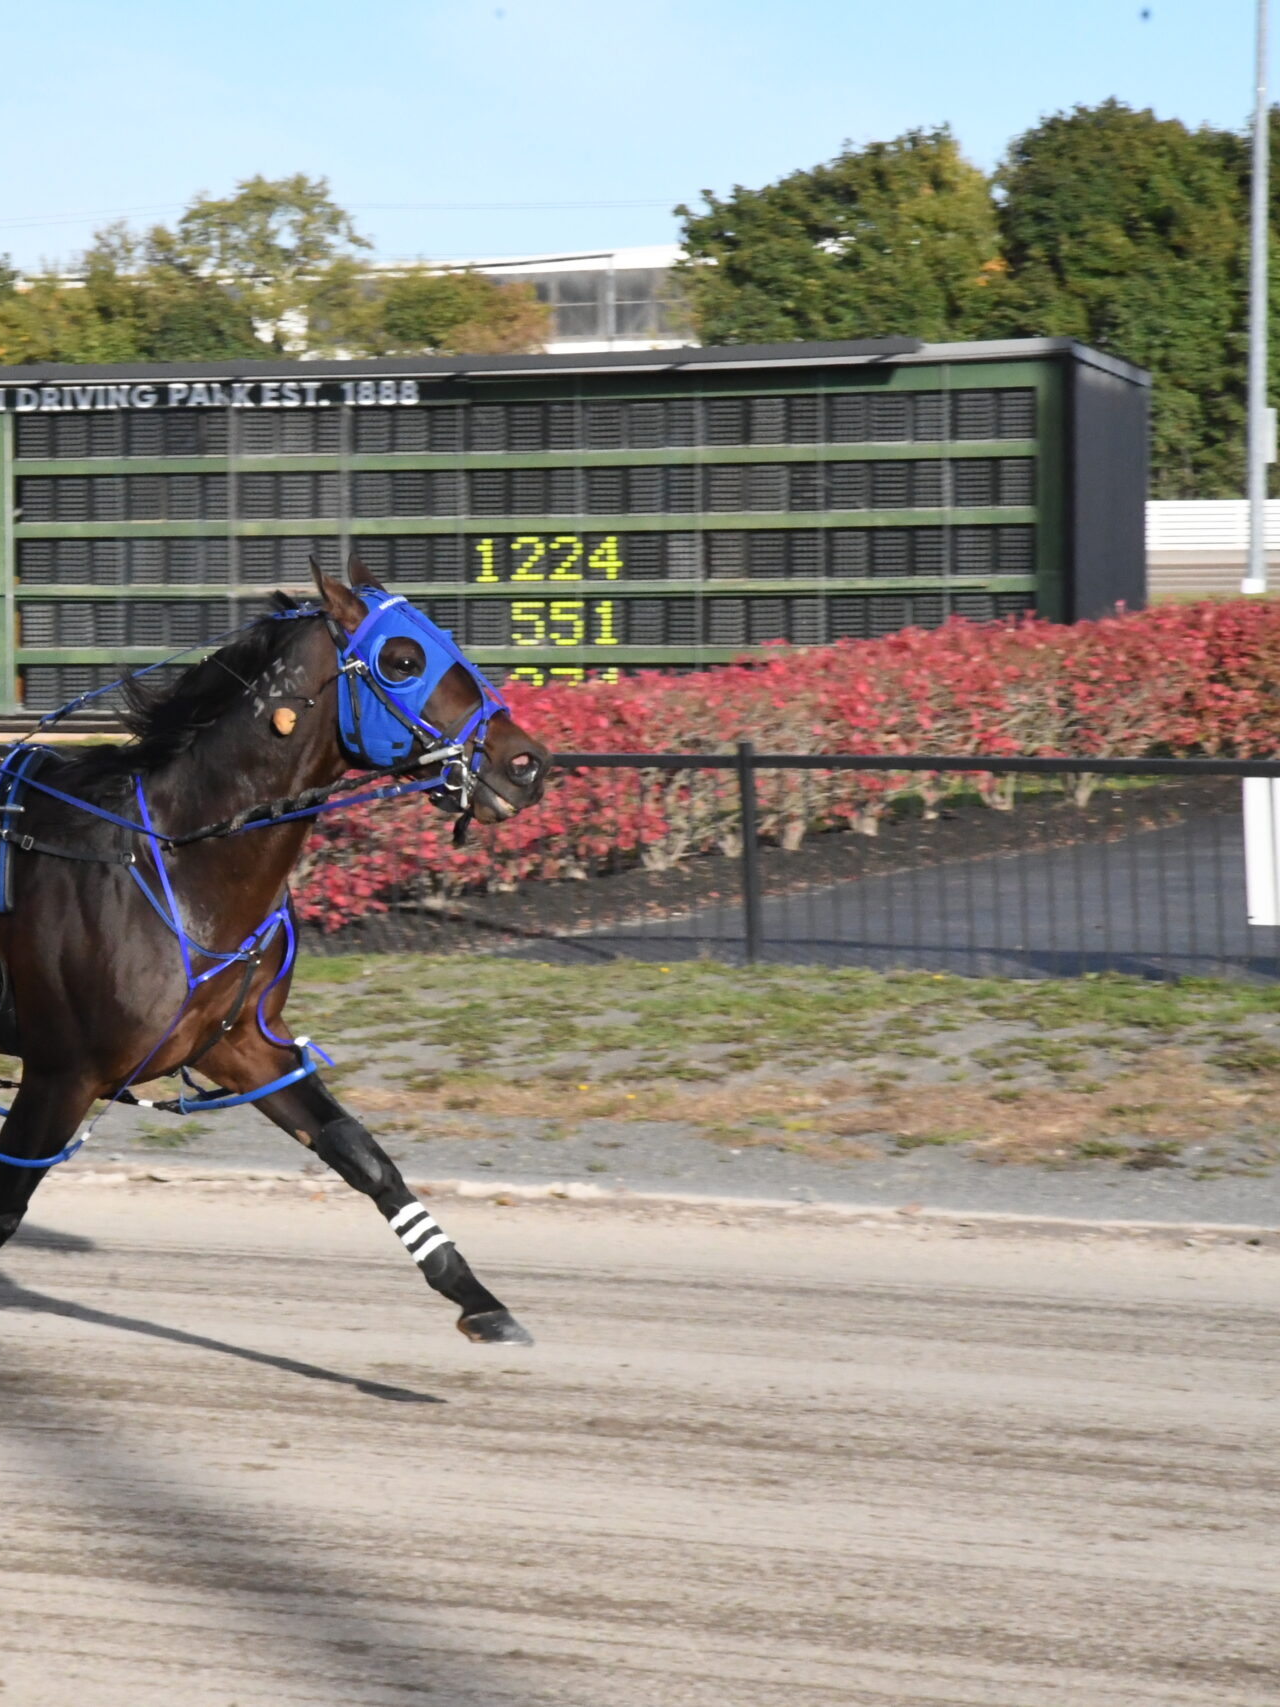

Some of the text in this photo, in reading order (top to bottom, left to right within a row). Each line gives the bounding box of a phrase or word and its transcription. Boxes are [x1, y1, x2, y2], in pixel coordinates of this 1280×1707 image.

[15, 385, 157, 412] DRIVING
[261, 382, 331, 407] EST.
[341, 381, 420, 406] 1888
[476, 536, 623, 583] 1224
[511, 600, 618, 645] 551
